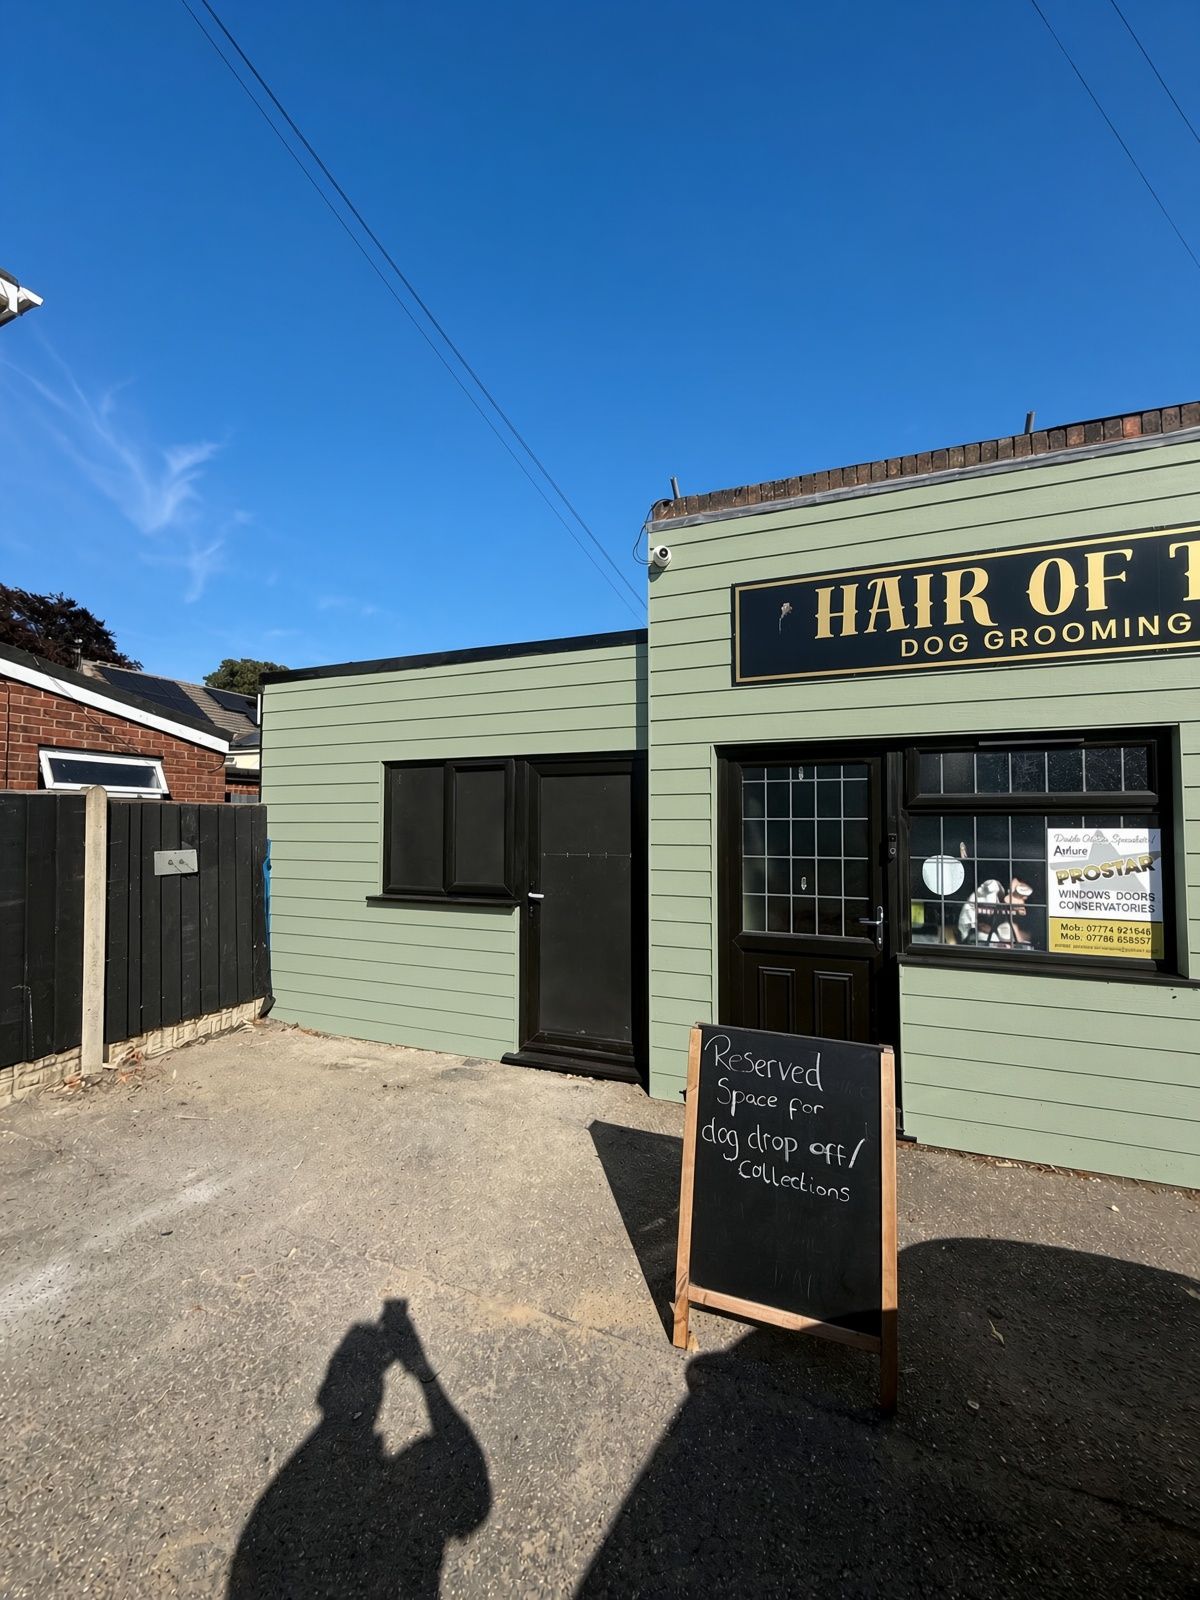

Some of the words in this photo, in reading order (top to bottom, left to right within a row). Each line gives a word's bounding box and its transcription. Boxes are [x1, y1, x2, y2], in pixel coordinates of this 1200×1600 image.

[814, 567, 998, 639] HAIR
[1025, 548, 1134, 616] OF
[901, 634, 969, 658] DOG
[984, 613, 1192, 650] GROOMING
[1056, 855, 1155, 885] PROSTAR
[1058, 889, 1111, 900] WINDOWS
[1116, 892, 1155, 902] DOORS
[1059, 900, 1155, 913] CONSERVATORIES
[1060, 923, 1083, 932] Mob:
[704, 1034, 824, 1092] Reserved
[716, 1077, 778, 1116] Space
[789, 1097, 825, 1120] for
[701, 1117, 739, 1161] dog
[747, 1123, 798, 1163] drop
